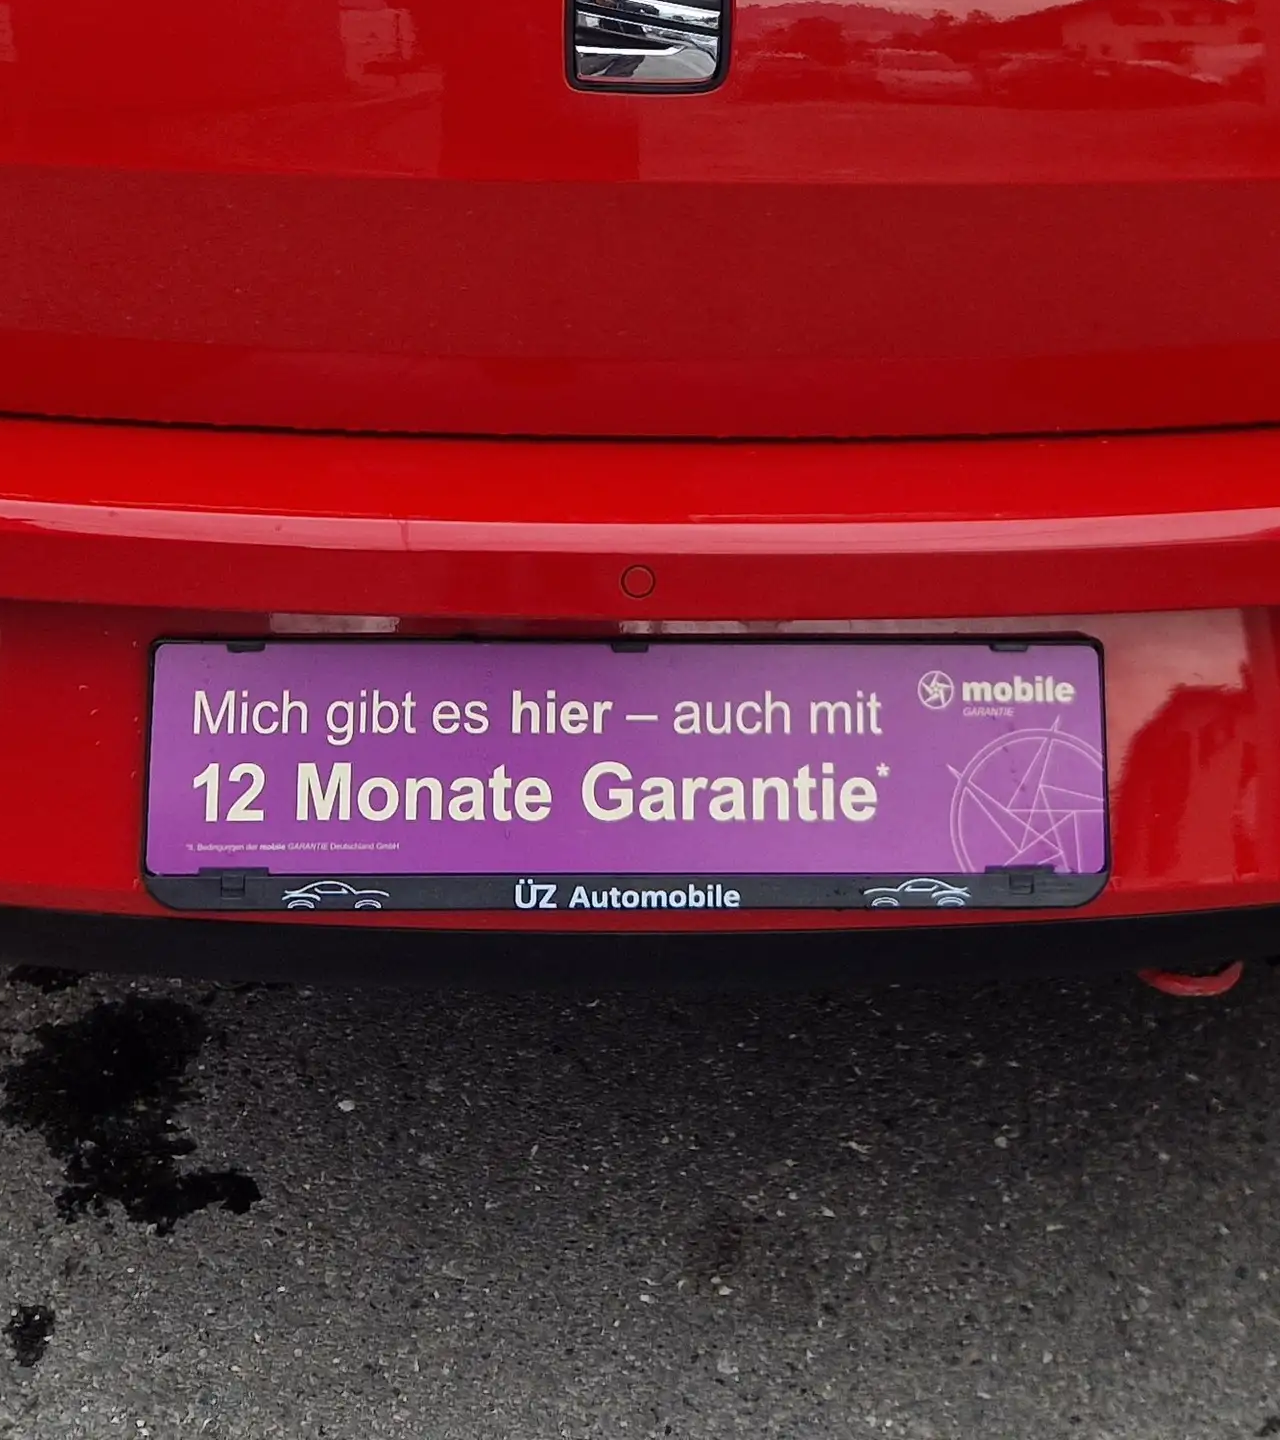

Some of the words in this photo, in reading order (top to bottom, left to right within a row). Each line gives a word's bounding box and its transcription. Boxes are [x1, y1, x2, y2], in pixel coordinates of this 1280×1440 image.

[962, 675, 1076, 703] mobile
[193, 690, 308, 735] Mich
[326, 690, 417, 746] gibt
[432, 700, 489, 734] es
[511, 690, 613, 734] hier
[673, 690, 792, 735] auch
[810, 690, 883, 735] mit
[963, 707, 1015, 718] GARANTIE
[193, 762, 266, 822] 12
[296, 762, 553, 822] Monate
[515, 879, 557, 908] ÜZ
[569, 883, 741, 908] Automobile
